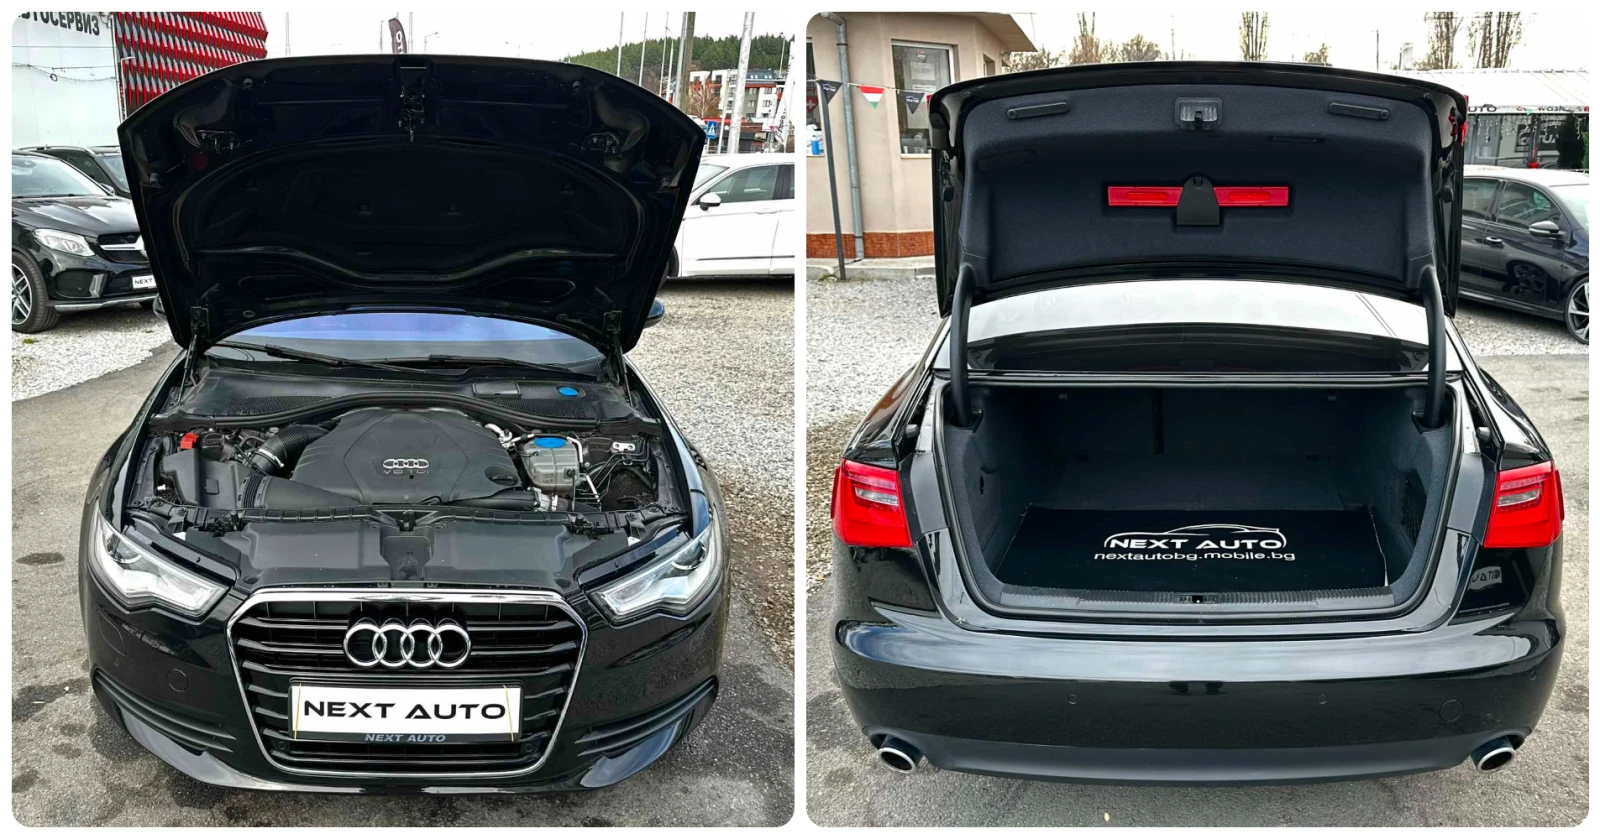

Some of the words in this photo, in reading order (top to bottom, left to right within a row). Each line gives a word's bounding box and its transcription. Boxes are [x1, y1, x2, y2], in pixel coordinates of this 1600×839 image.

[1109, 538, 1189, 549] NEXT
[1195, 539, 1283, 549] AUTO
[1094, 551, 1296, 561] nextautobg.mobile.bg
[304, 700, 396, 719] NEXT
[404, 703, 507, 720] AUTO
[364, 733, 404, 742] NEXT
[406, 734, 447, 743] AUTO
